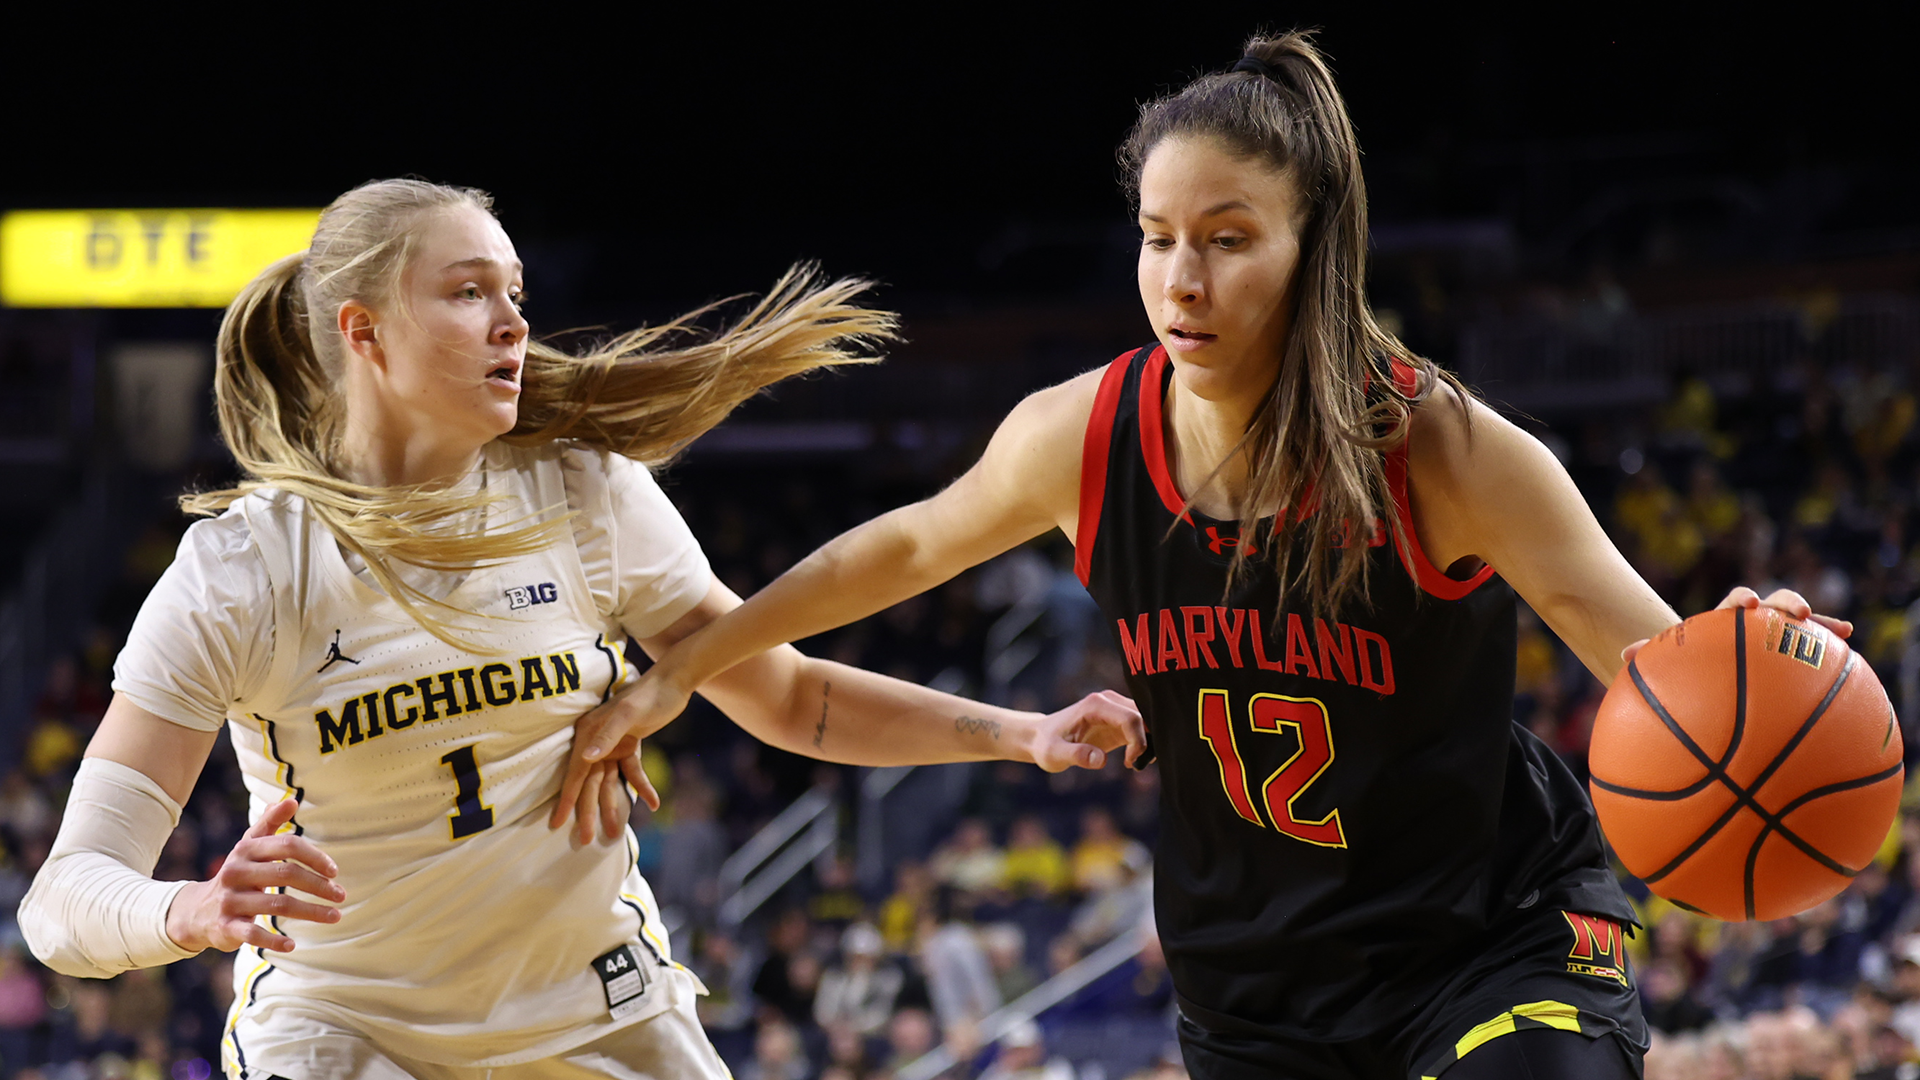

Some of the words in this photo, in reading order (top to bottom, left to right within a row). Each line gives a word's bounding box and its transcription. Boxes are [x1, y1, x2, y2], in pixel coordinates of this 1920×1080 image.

[1117, 606, 1396, 696] MARYLAND
[314, 651, 581, 755] MICHIGAN
[441, 742, 494, 841] 1
[1198, 689, 1348, 849] 12
[605, 953, 628, 973] 44
